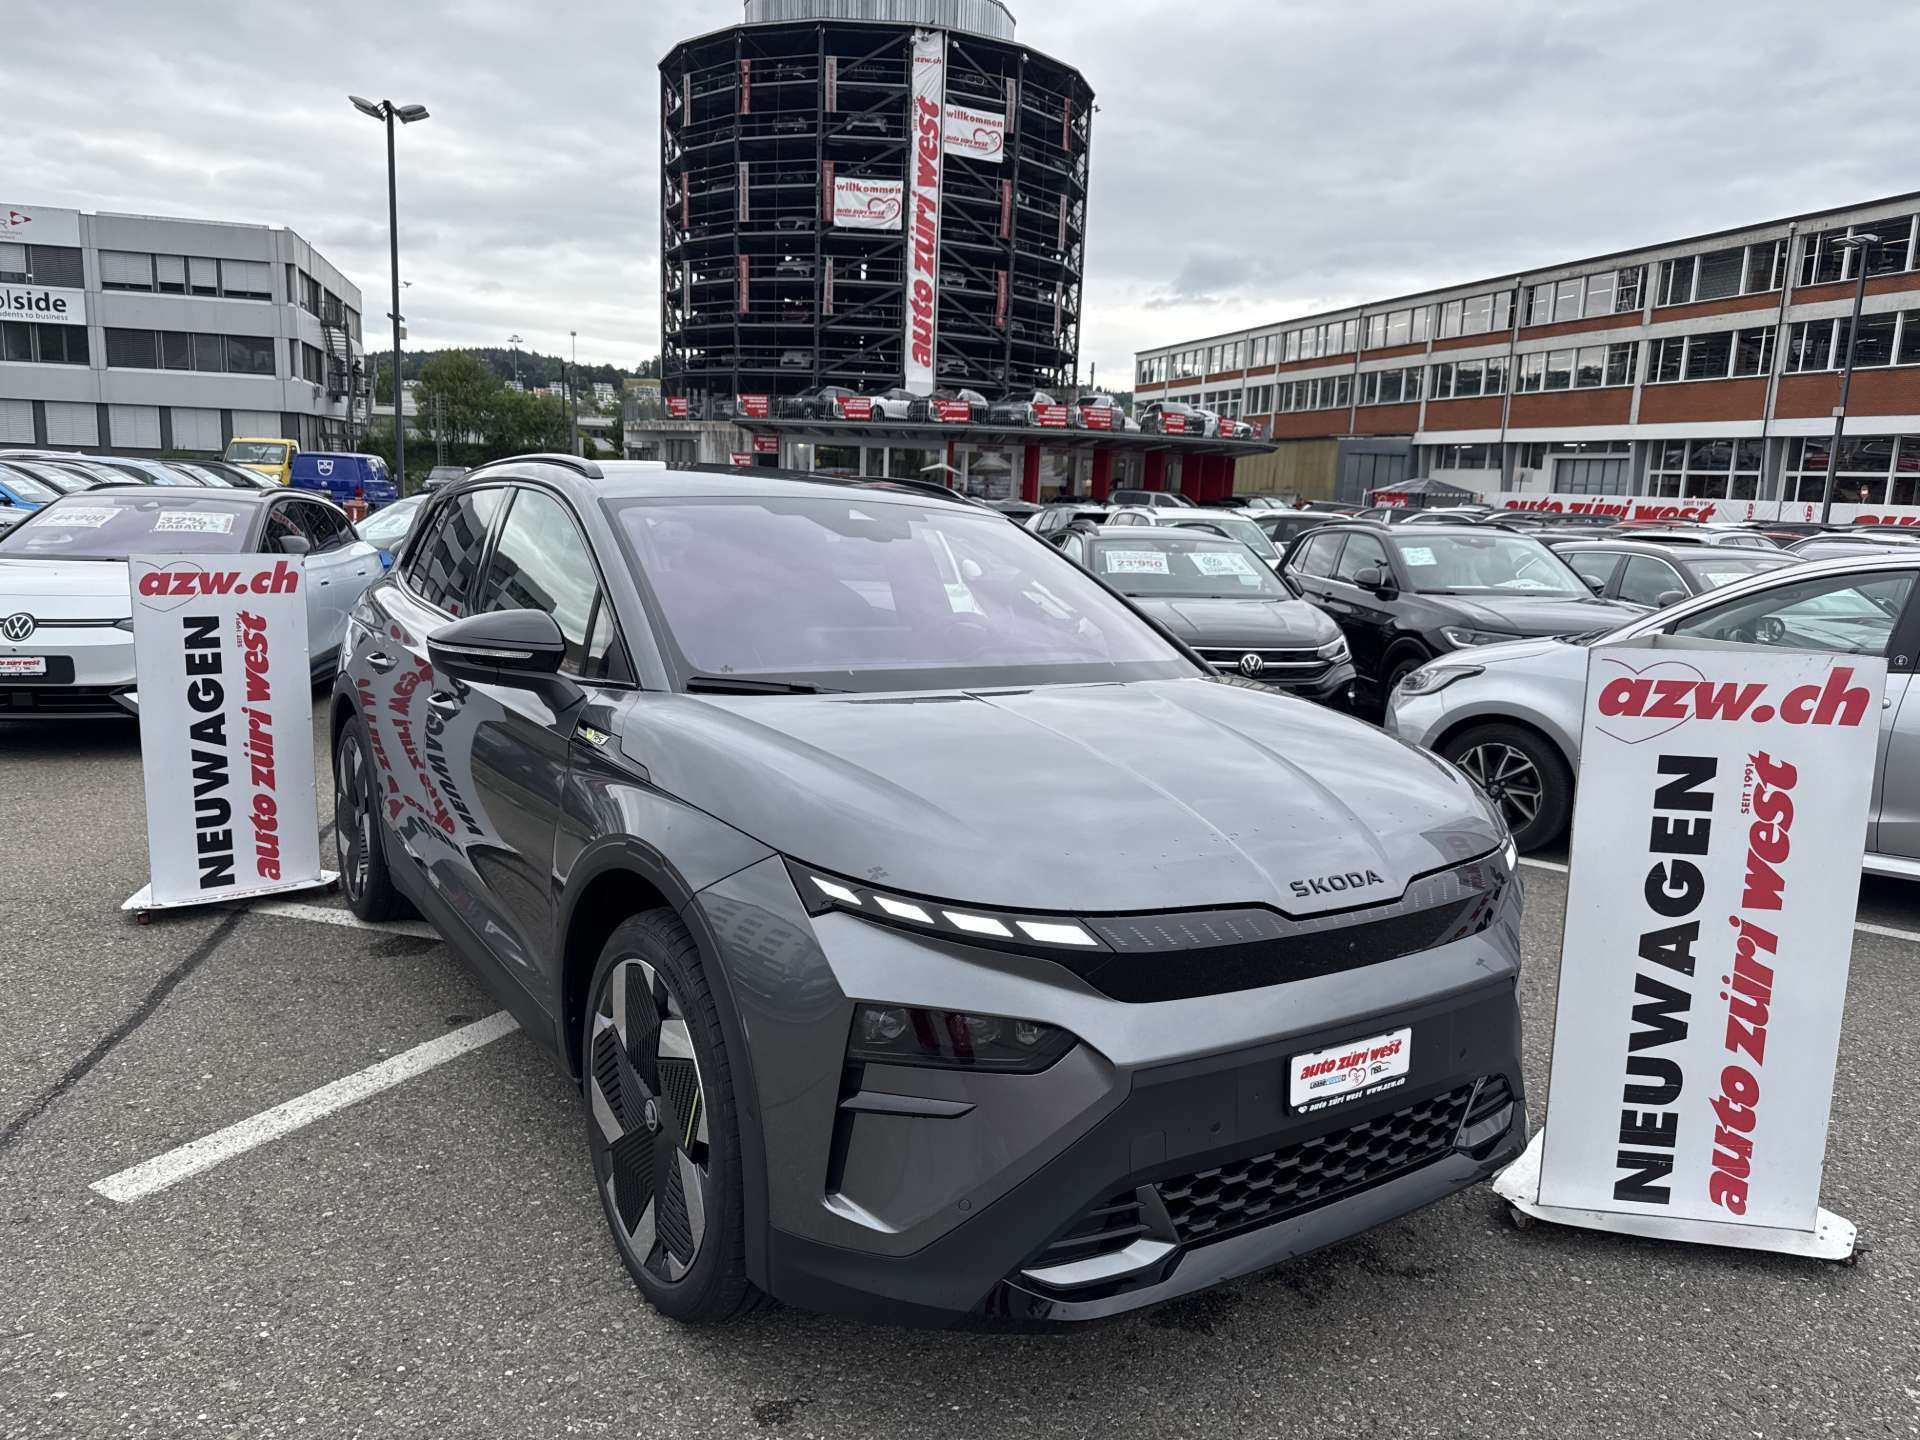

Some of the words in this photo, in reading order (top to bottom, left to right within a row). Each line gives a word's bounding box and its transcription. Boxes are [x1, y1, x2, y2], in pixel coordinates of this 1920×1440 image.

[916, 95, 940, 188] west
[946, 110, 1003, 128] willkommen
[836, 182, 901, 194] willkommen
[909, 190, 937, 278] züri
[35, 312, 69, 321] business
[910, 279, 935, 370] auto
[1634, 502, 1716, 523] west
[138, 560, 299, 597] azw.ch
[236, 609, 271, 702] west
[1598, 666, 1871, 727] azw.ch
[182, 614, 237, 890] NEUWAGEN
[241, 706, 277, 791] züri
[1743, 763, 1755, 788] 1991
[250, 794, 281, 881] auto
[1740, 750, 1798, 911] west
[1741, 791, 1751, 815] SEIT
[1613, 754, 1718, 1205] NEUWAGEN
[1720, 914, 1778, 1067] züri
[1300, 1058, 1336, 1080] auto
[1336, 1047, 1370, 1071] züri
[1370, 1039, 1402, 1062] west
[1309, 1102, 1327, 1111] auto
[1345, 1090, 1363, 1102] west
[1708, 1066, 1760, 1217] auto
